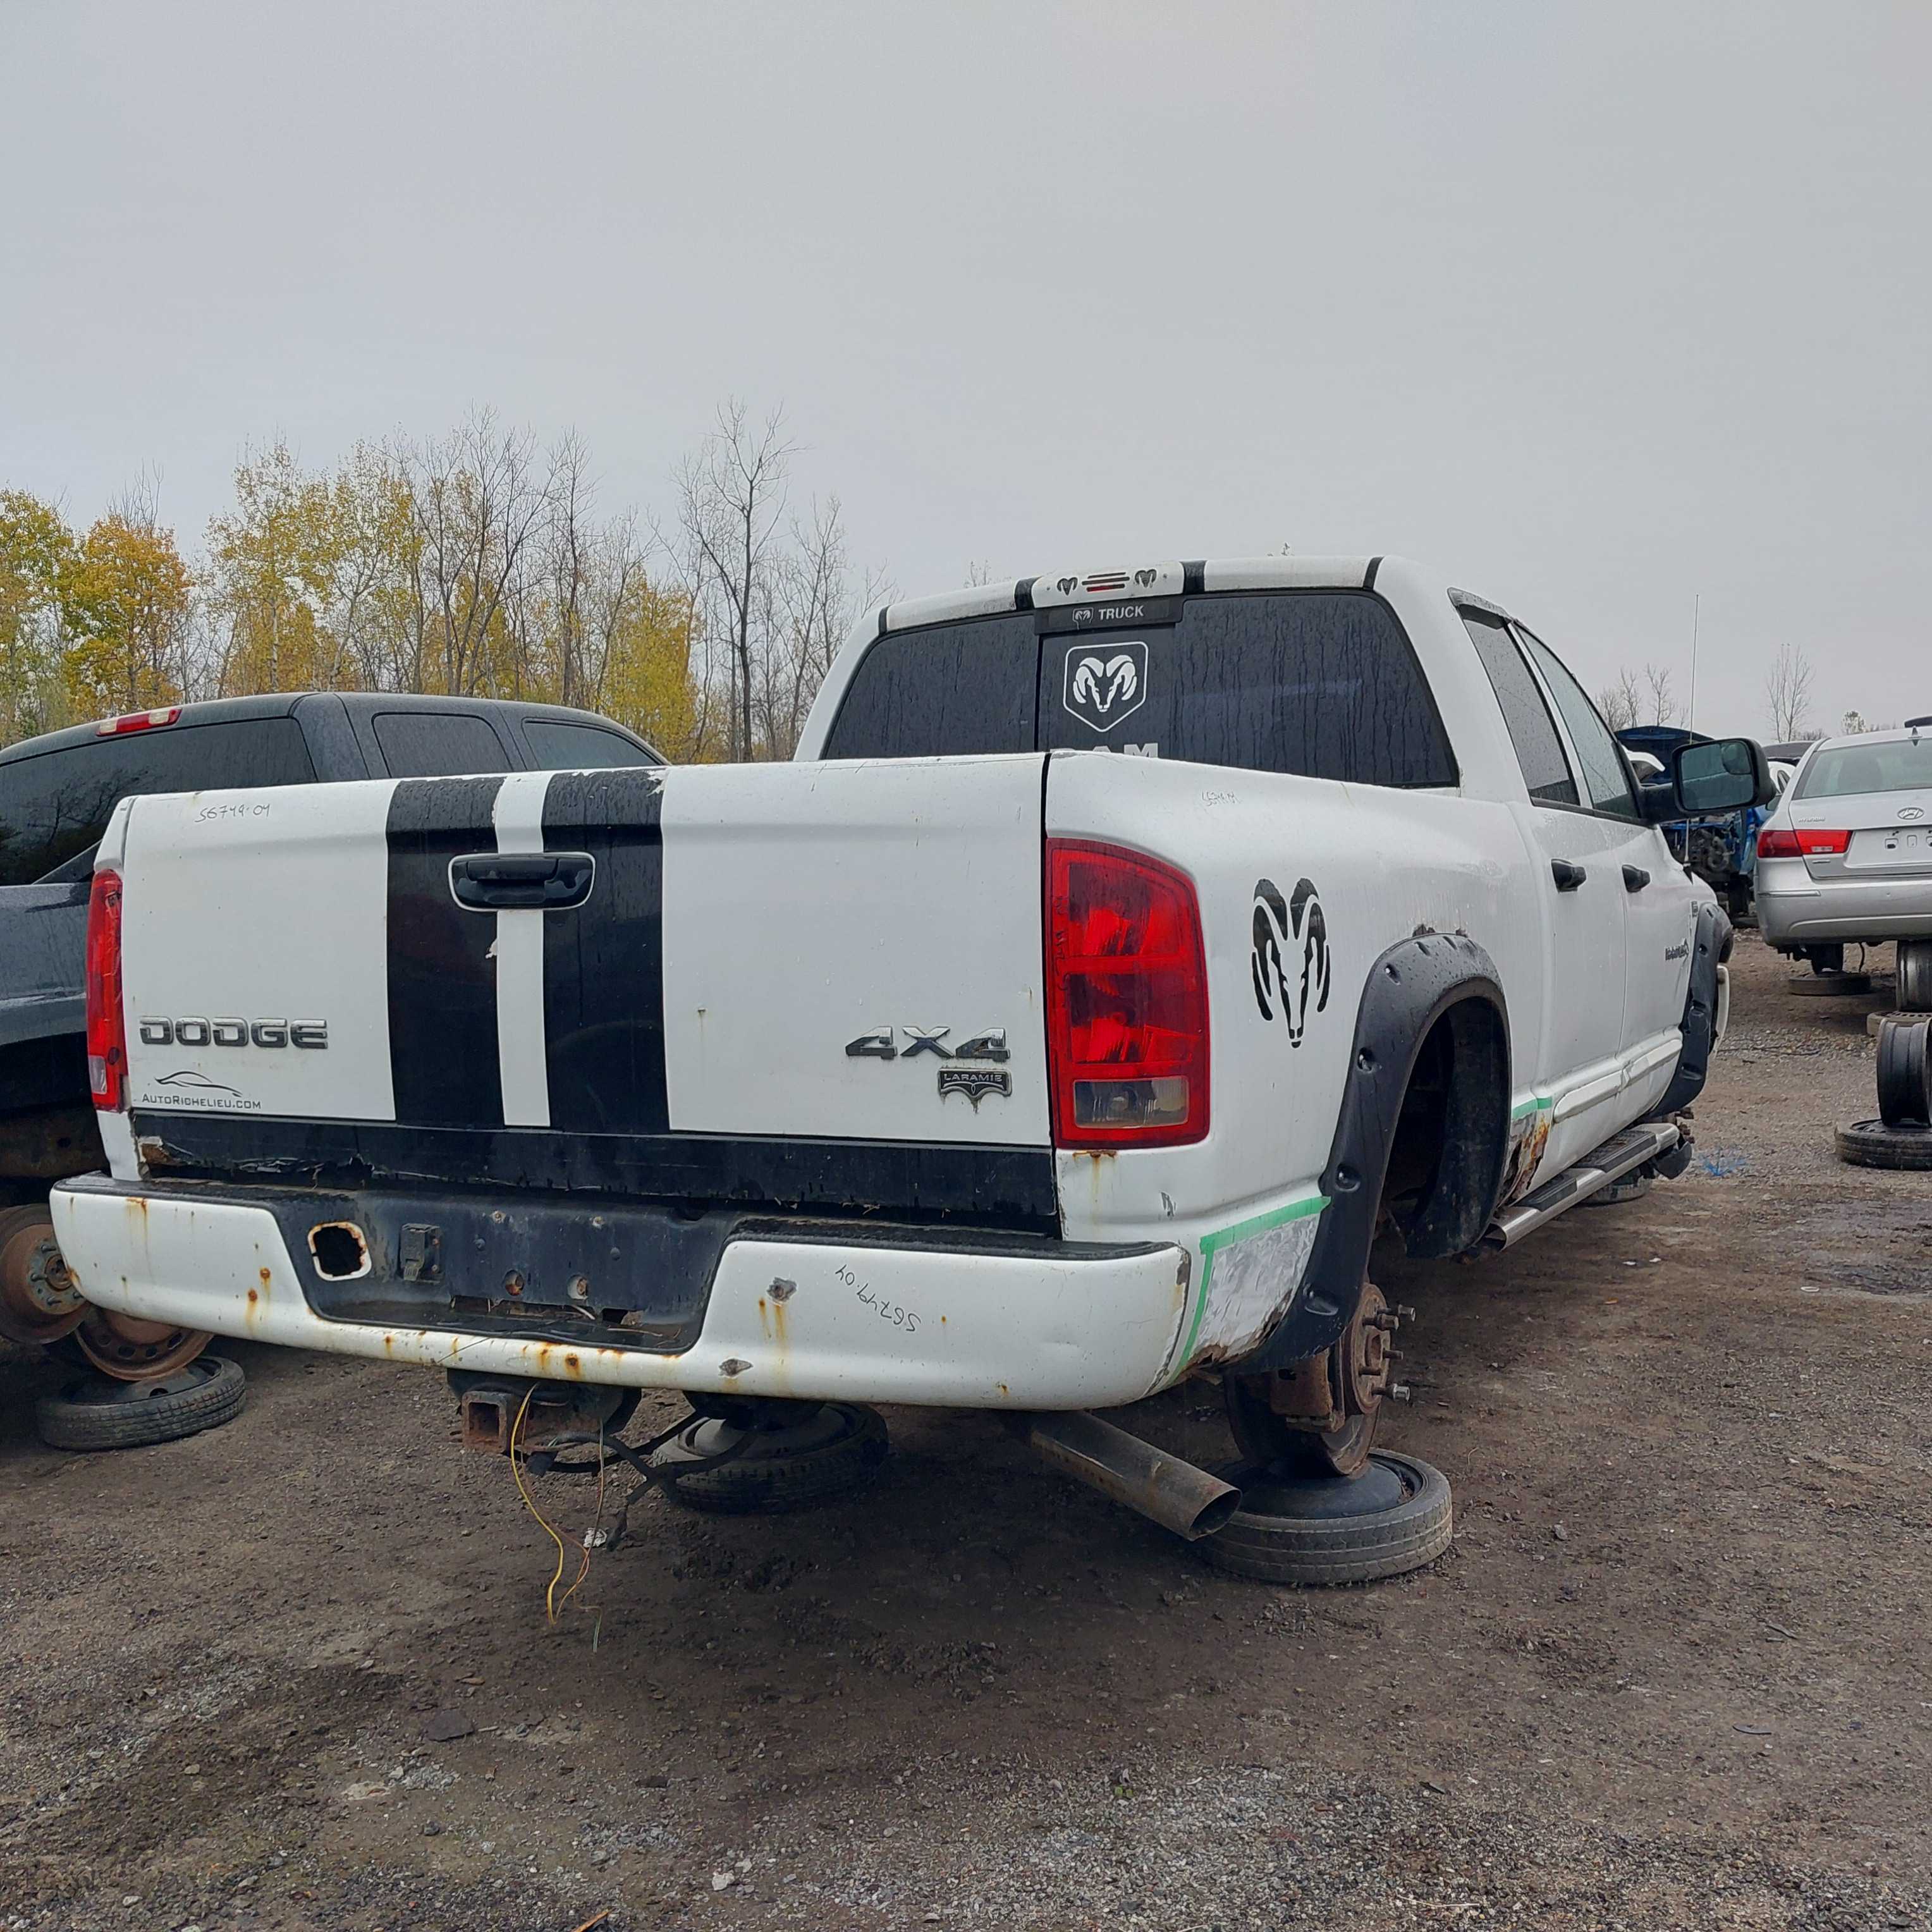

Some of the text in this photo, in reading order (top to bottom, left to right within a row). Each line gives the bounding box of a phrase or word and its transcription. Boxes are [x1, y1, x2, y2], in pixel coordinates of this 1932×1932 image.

[1098, 605, 1145, 621] TRUCK
[139, 1016, 328, 1049] DODGE
[845, 1026, 1010, 1063] 4X4
[943, 1073, 1003, 1083] LARAMIE
